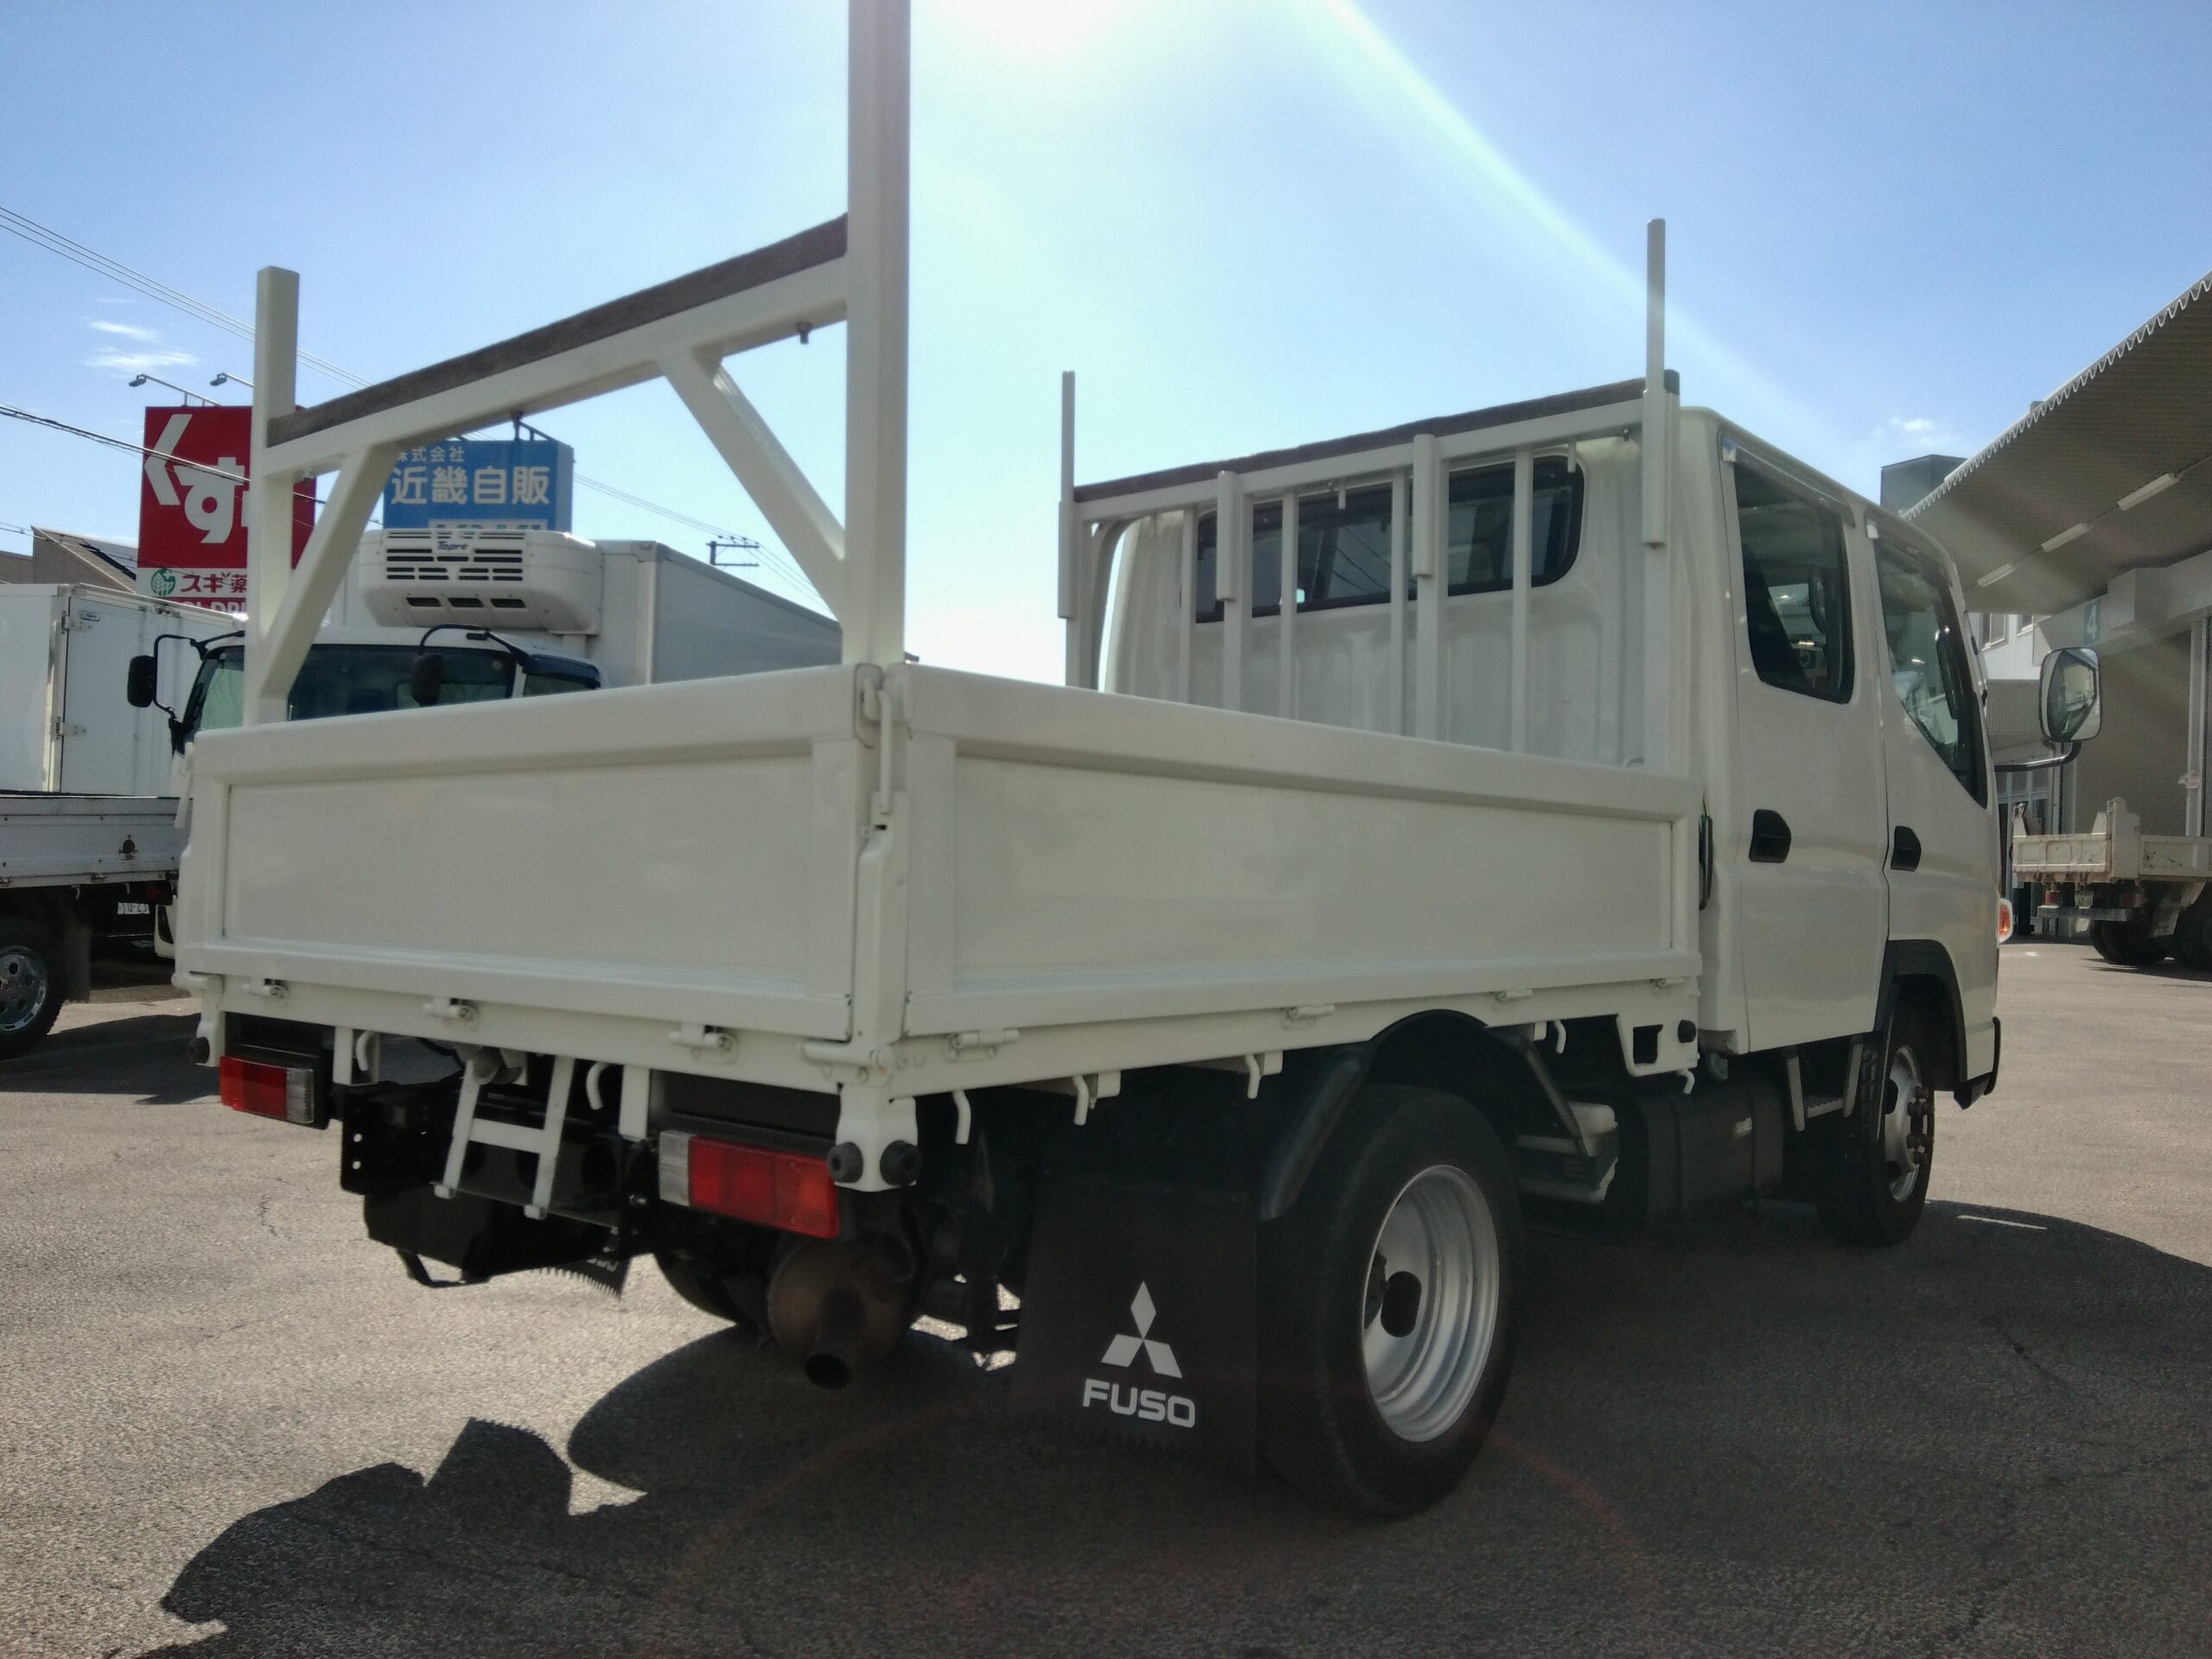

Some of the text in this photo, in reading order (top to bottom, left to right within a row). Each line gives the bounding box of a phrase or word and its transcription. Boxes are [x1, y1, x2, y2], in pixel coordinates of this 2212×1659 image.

[143, 413, 253, 544] くす
[391, 465, 551, 505] 近畿自販
[2086, 604, 2098, 641] 4
[1083, 1377, 1196, 1429] FUSO
